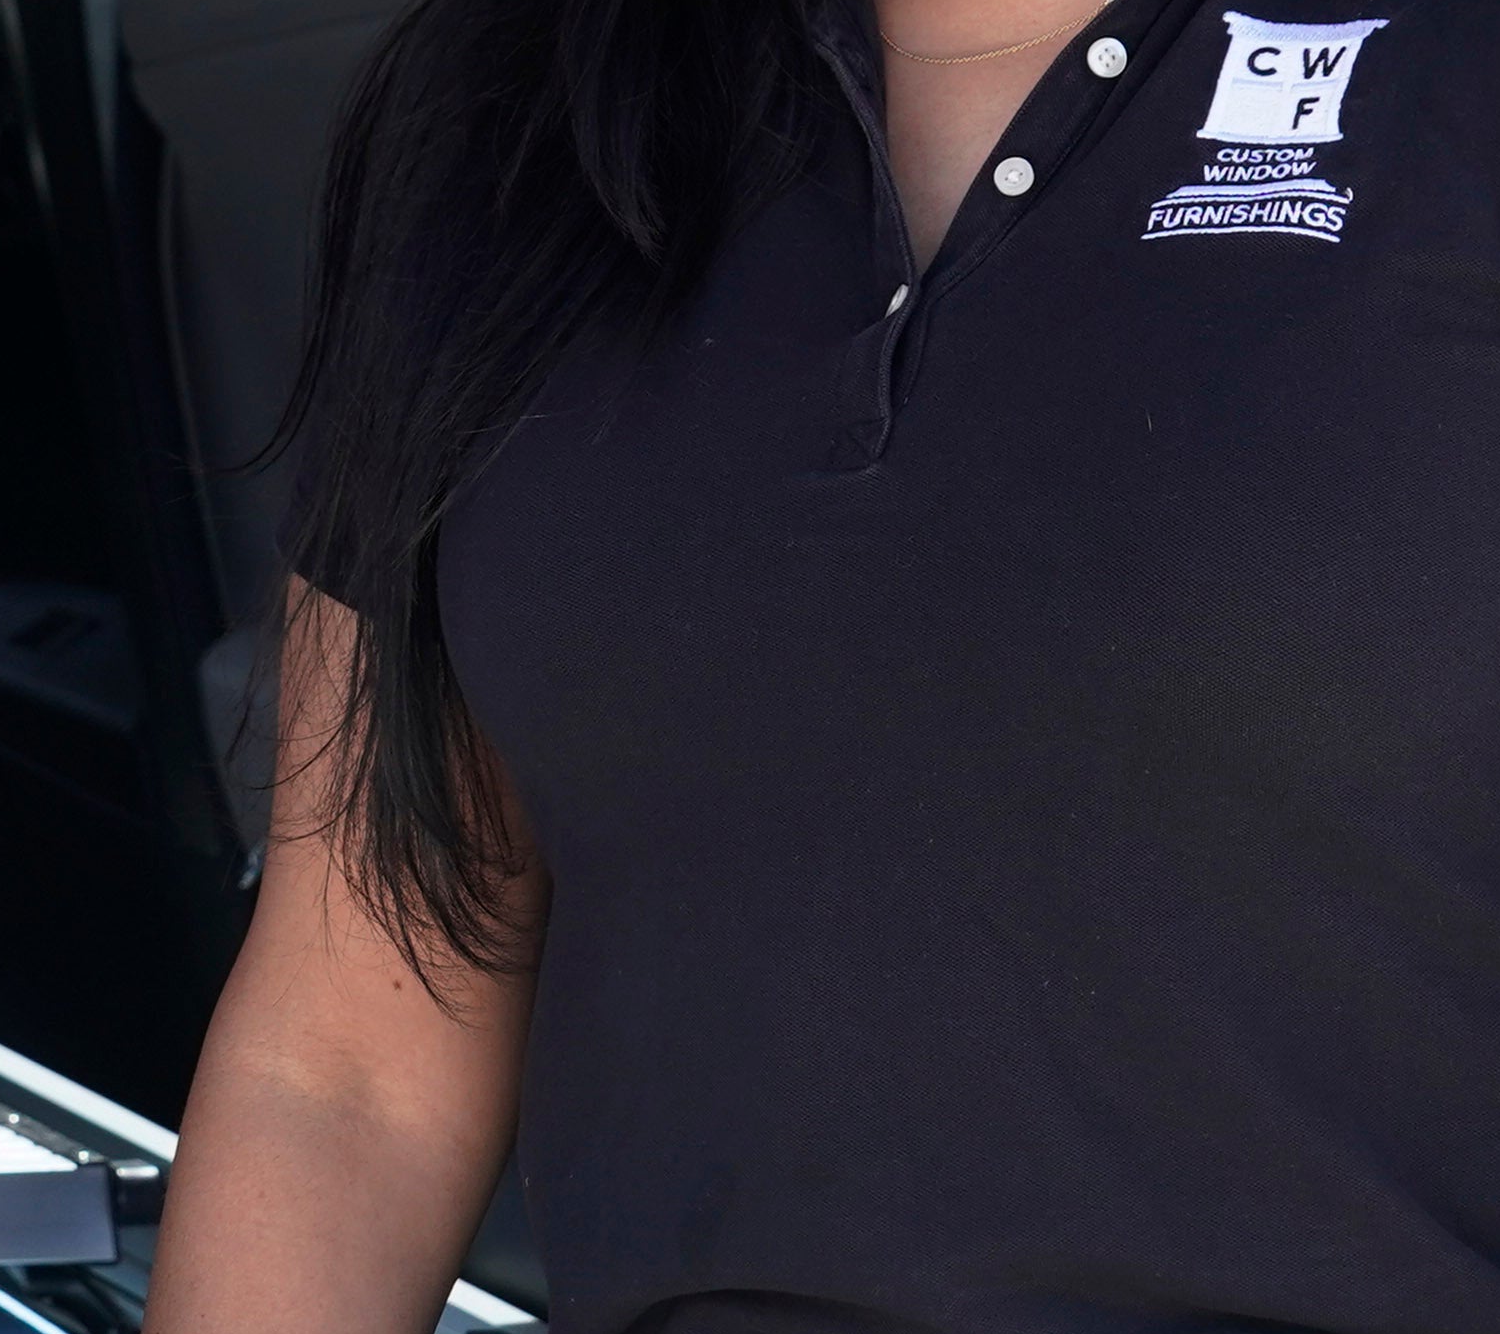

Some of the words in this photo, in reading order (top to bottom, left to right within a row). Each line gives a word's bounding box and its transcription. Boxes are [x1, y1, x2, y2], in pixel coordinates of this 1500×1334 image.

[1246, 46, 1281, 77] C
[1303, 46, 1347, 80] W
[1291, 97, 1320, 131] F
[1216, 147, 1316, 163] CUSTOM
[1203, 161, 1317, 182] WINDOW
[1147, 200, 1348, 232] FURNISHINGS
